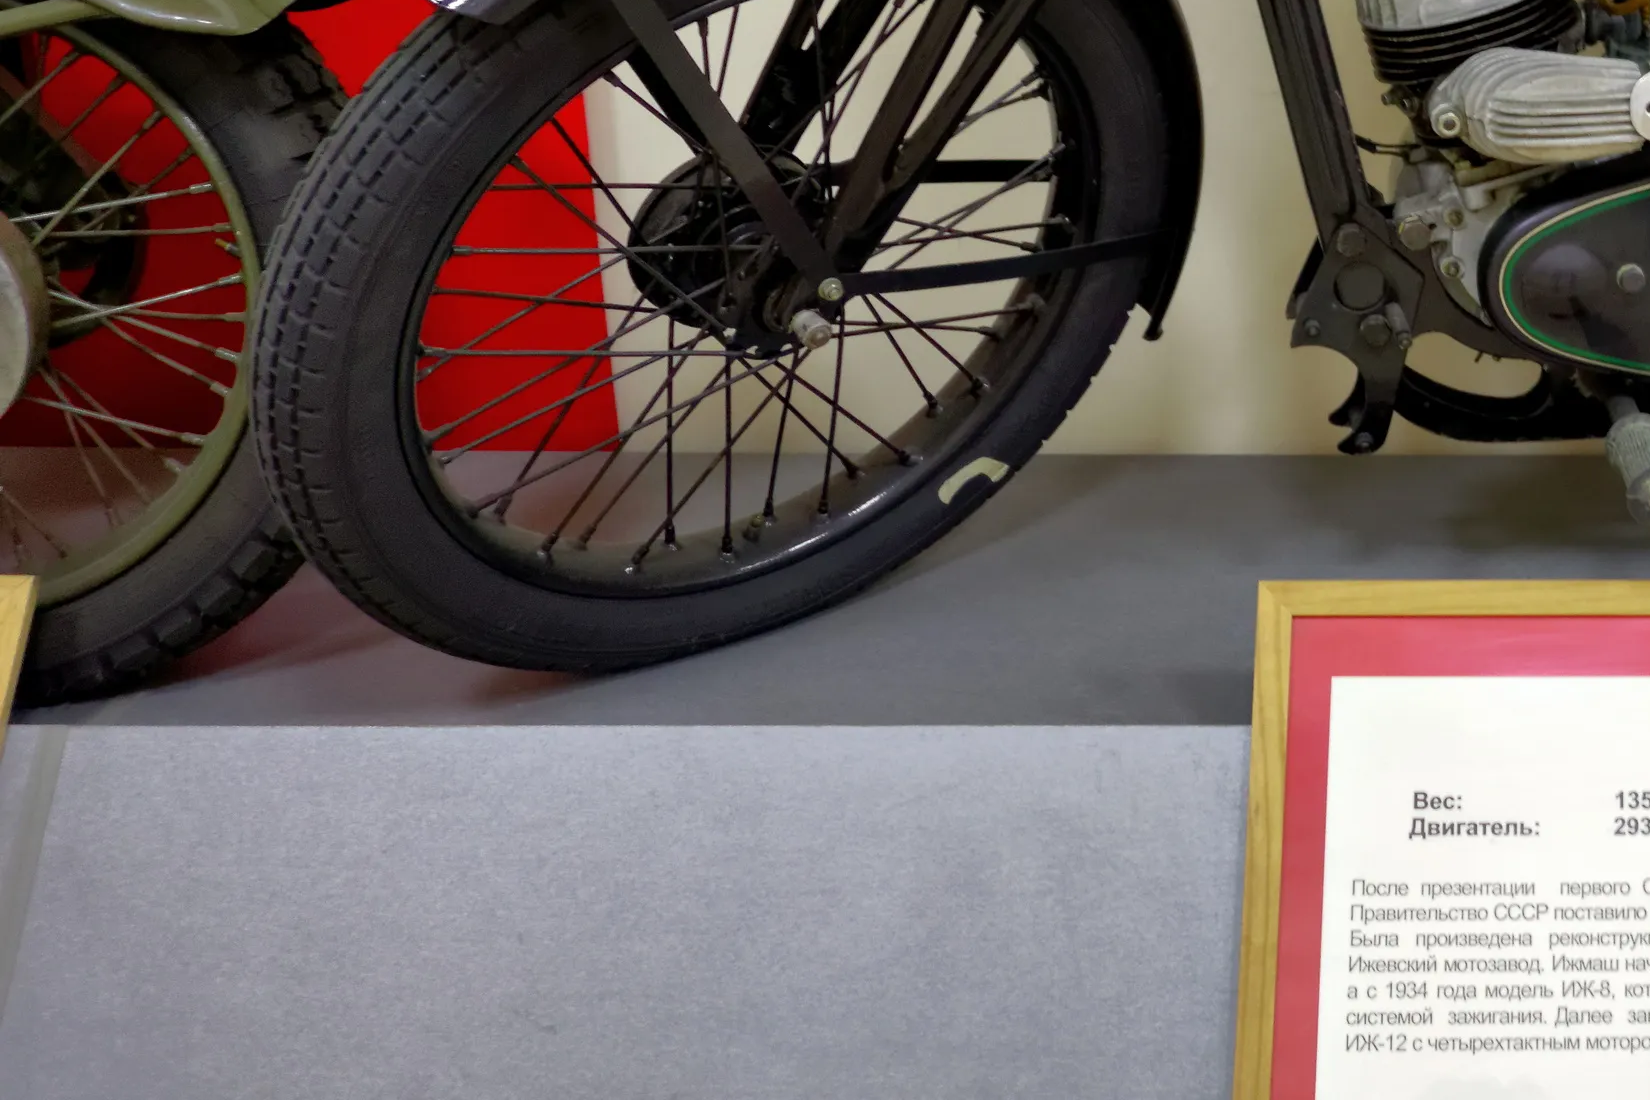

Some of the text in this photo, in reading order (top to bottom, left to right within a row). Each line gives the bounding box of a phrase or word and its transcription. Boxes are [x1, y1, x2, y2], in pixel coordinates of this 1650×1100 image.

[1412, 789, 1463, 813] Вес:
[1407, 815, 1541, 842] Двигатель:
[1351, 878, 1410, 898] После
[1420, 881, 1536, 902] презентации
[1559, 881, 1632, 901] первого
[1350, 902, 1489, 927] Правительство
[1493, 902, 1550, 922] СССР
[1553, 905, 1648, 922] поставило
[1349, 928, 1400, 949] Была
[1415, 932, 1533, 952] произведена
[1348, 953, 1438, 974] Ижевский
[1443, 957, 1545, 976] мотозавод.
[1551, 952, 1620, 974] Ижмаш
[1385, 979, 1429, 1001] 1934
[1436, 984, 1478, 1002] года
[1484, 983, 1554, 1002] модель
[1561, 978, 1616, 1002] ИЖ-8,
[1345, 1006, 1434, 1027] системой
[1447, 1010, 1548, 1026] зажигания.
[1553, 1004, 1614, 1029] Далее
[1345, 1033, 1408, 1053] ИЖ-12
[1427, 1036, 1581, 1056] четырехтактным
